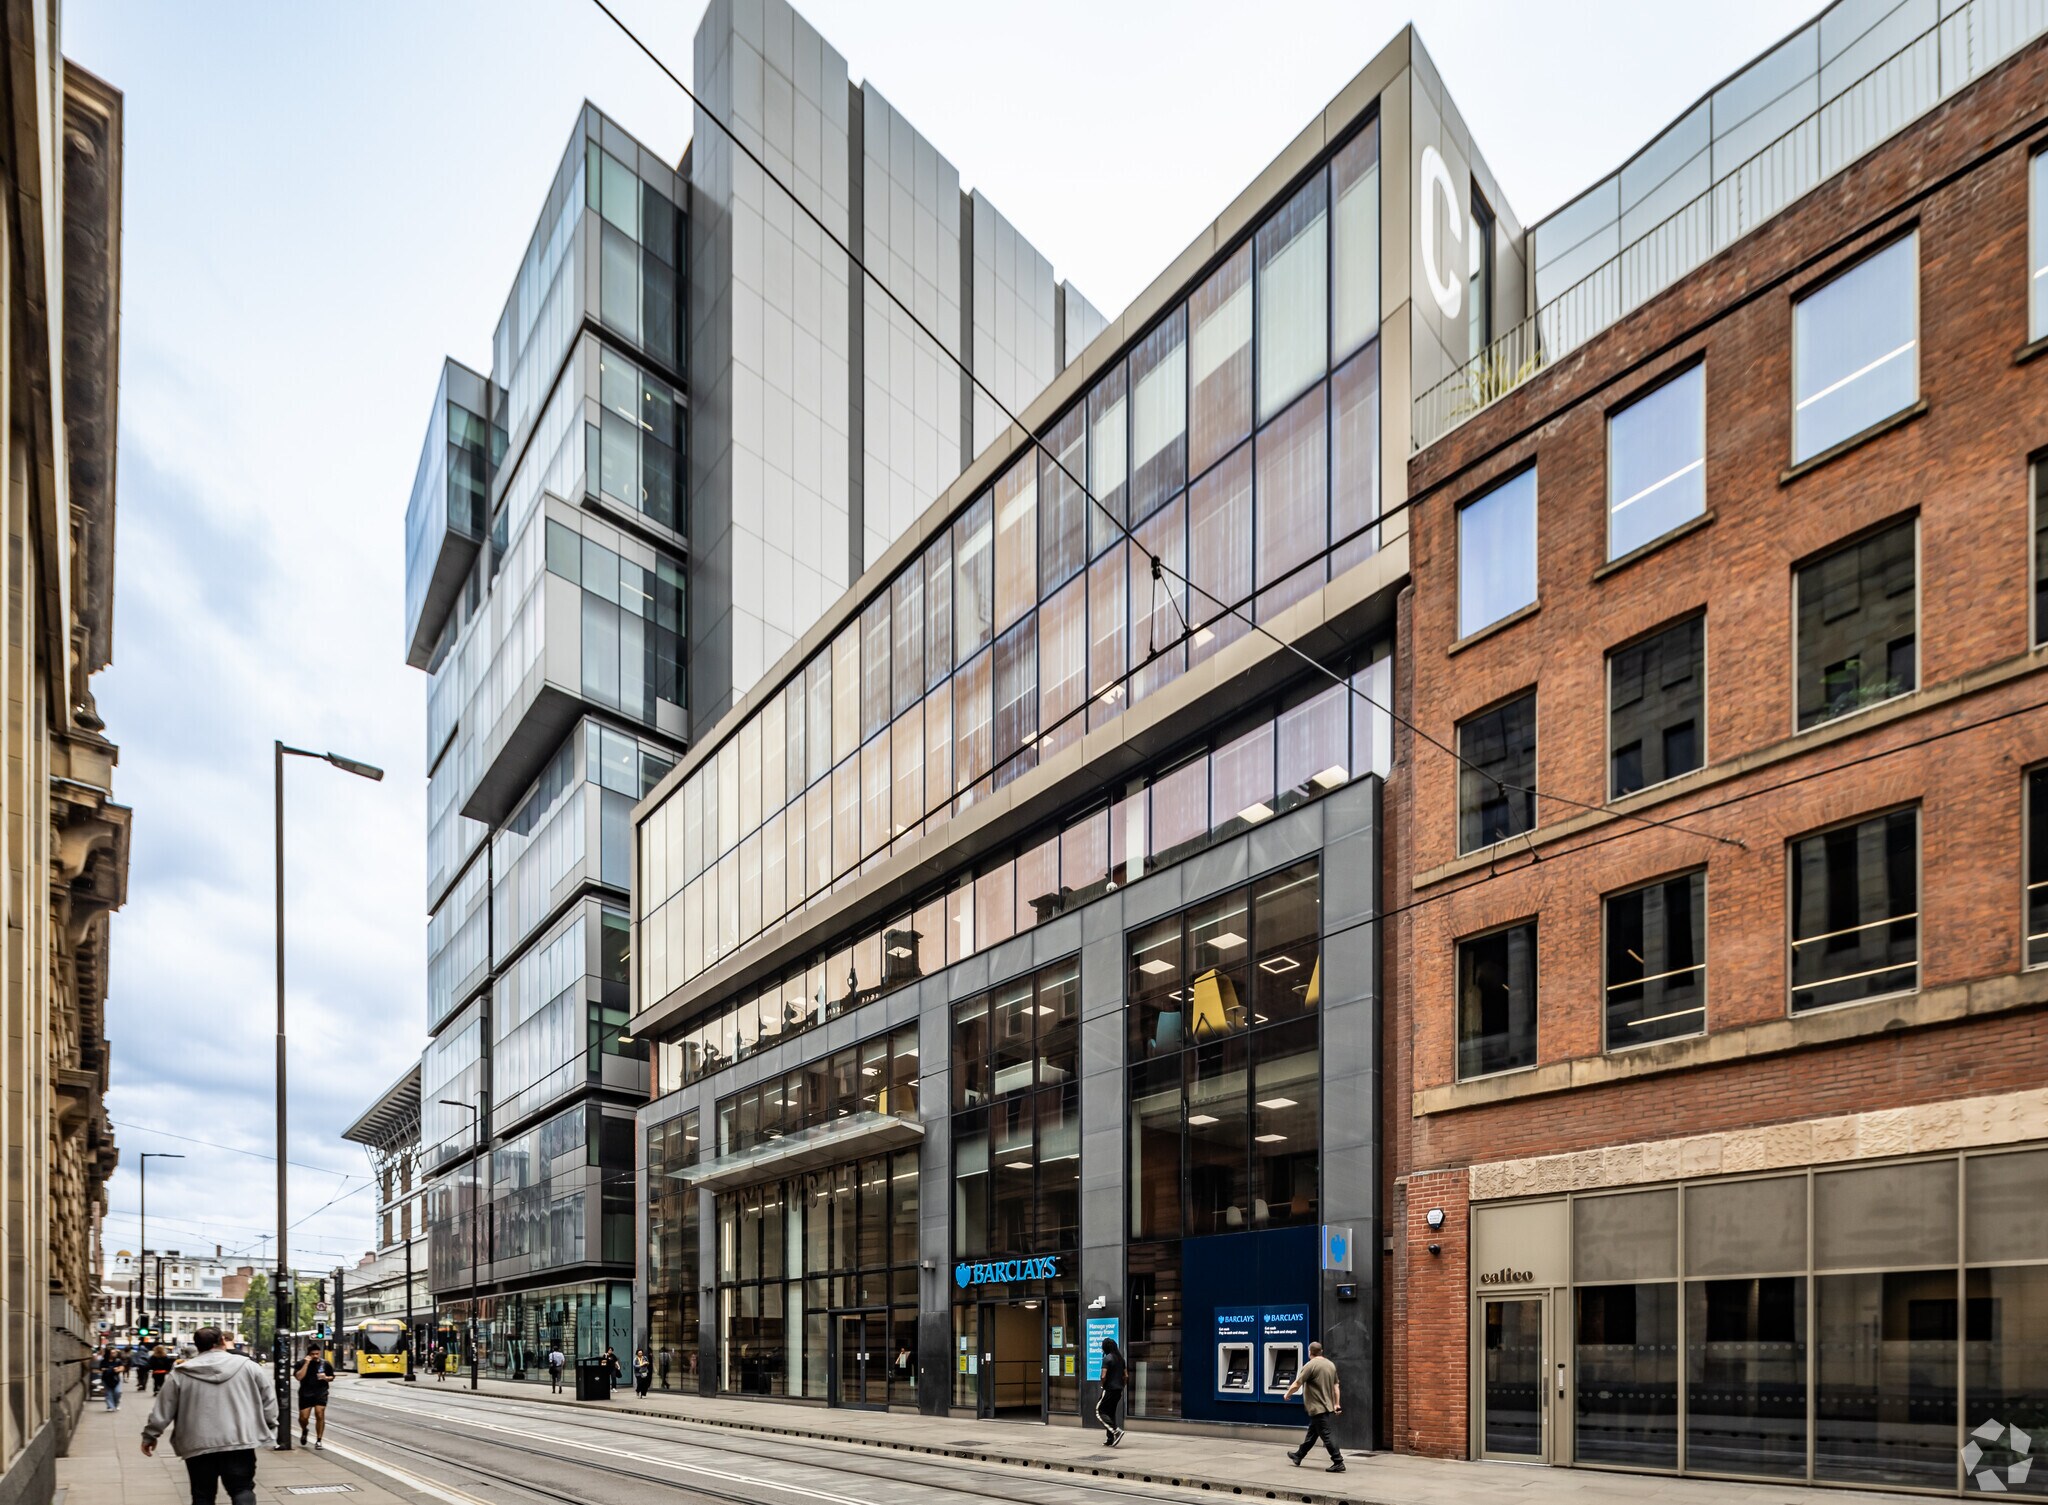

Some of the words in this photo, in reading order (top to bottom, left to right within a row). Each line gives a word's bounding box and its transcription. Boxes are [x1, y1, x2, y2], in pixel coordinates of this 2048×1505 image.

[1420, 144, 1463, 321] C
[973, 1255, 1057, 1285] BARCLAYS
[1481, 1267, 1535, 1285] calico
[1225, 1315, 1255, 1323] BARCLAYS
[1271, 1313, 1304, 1321] BARCLAYS
